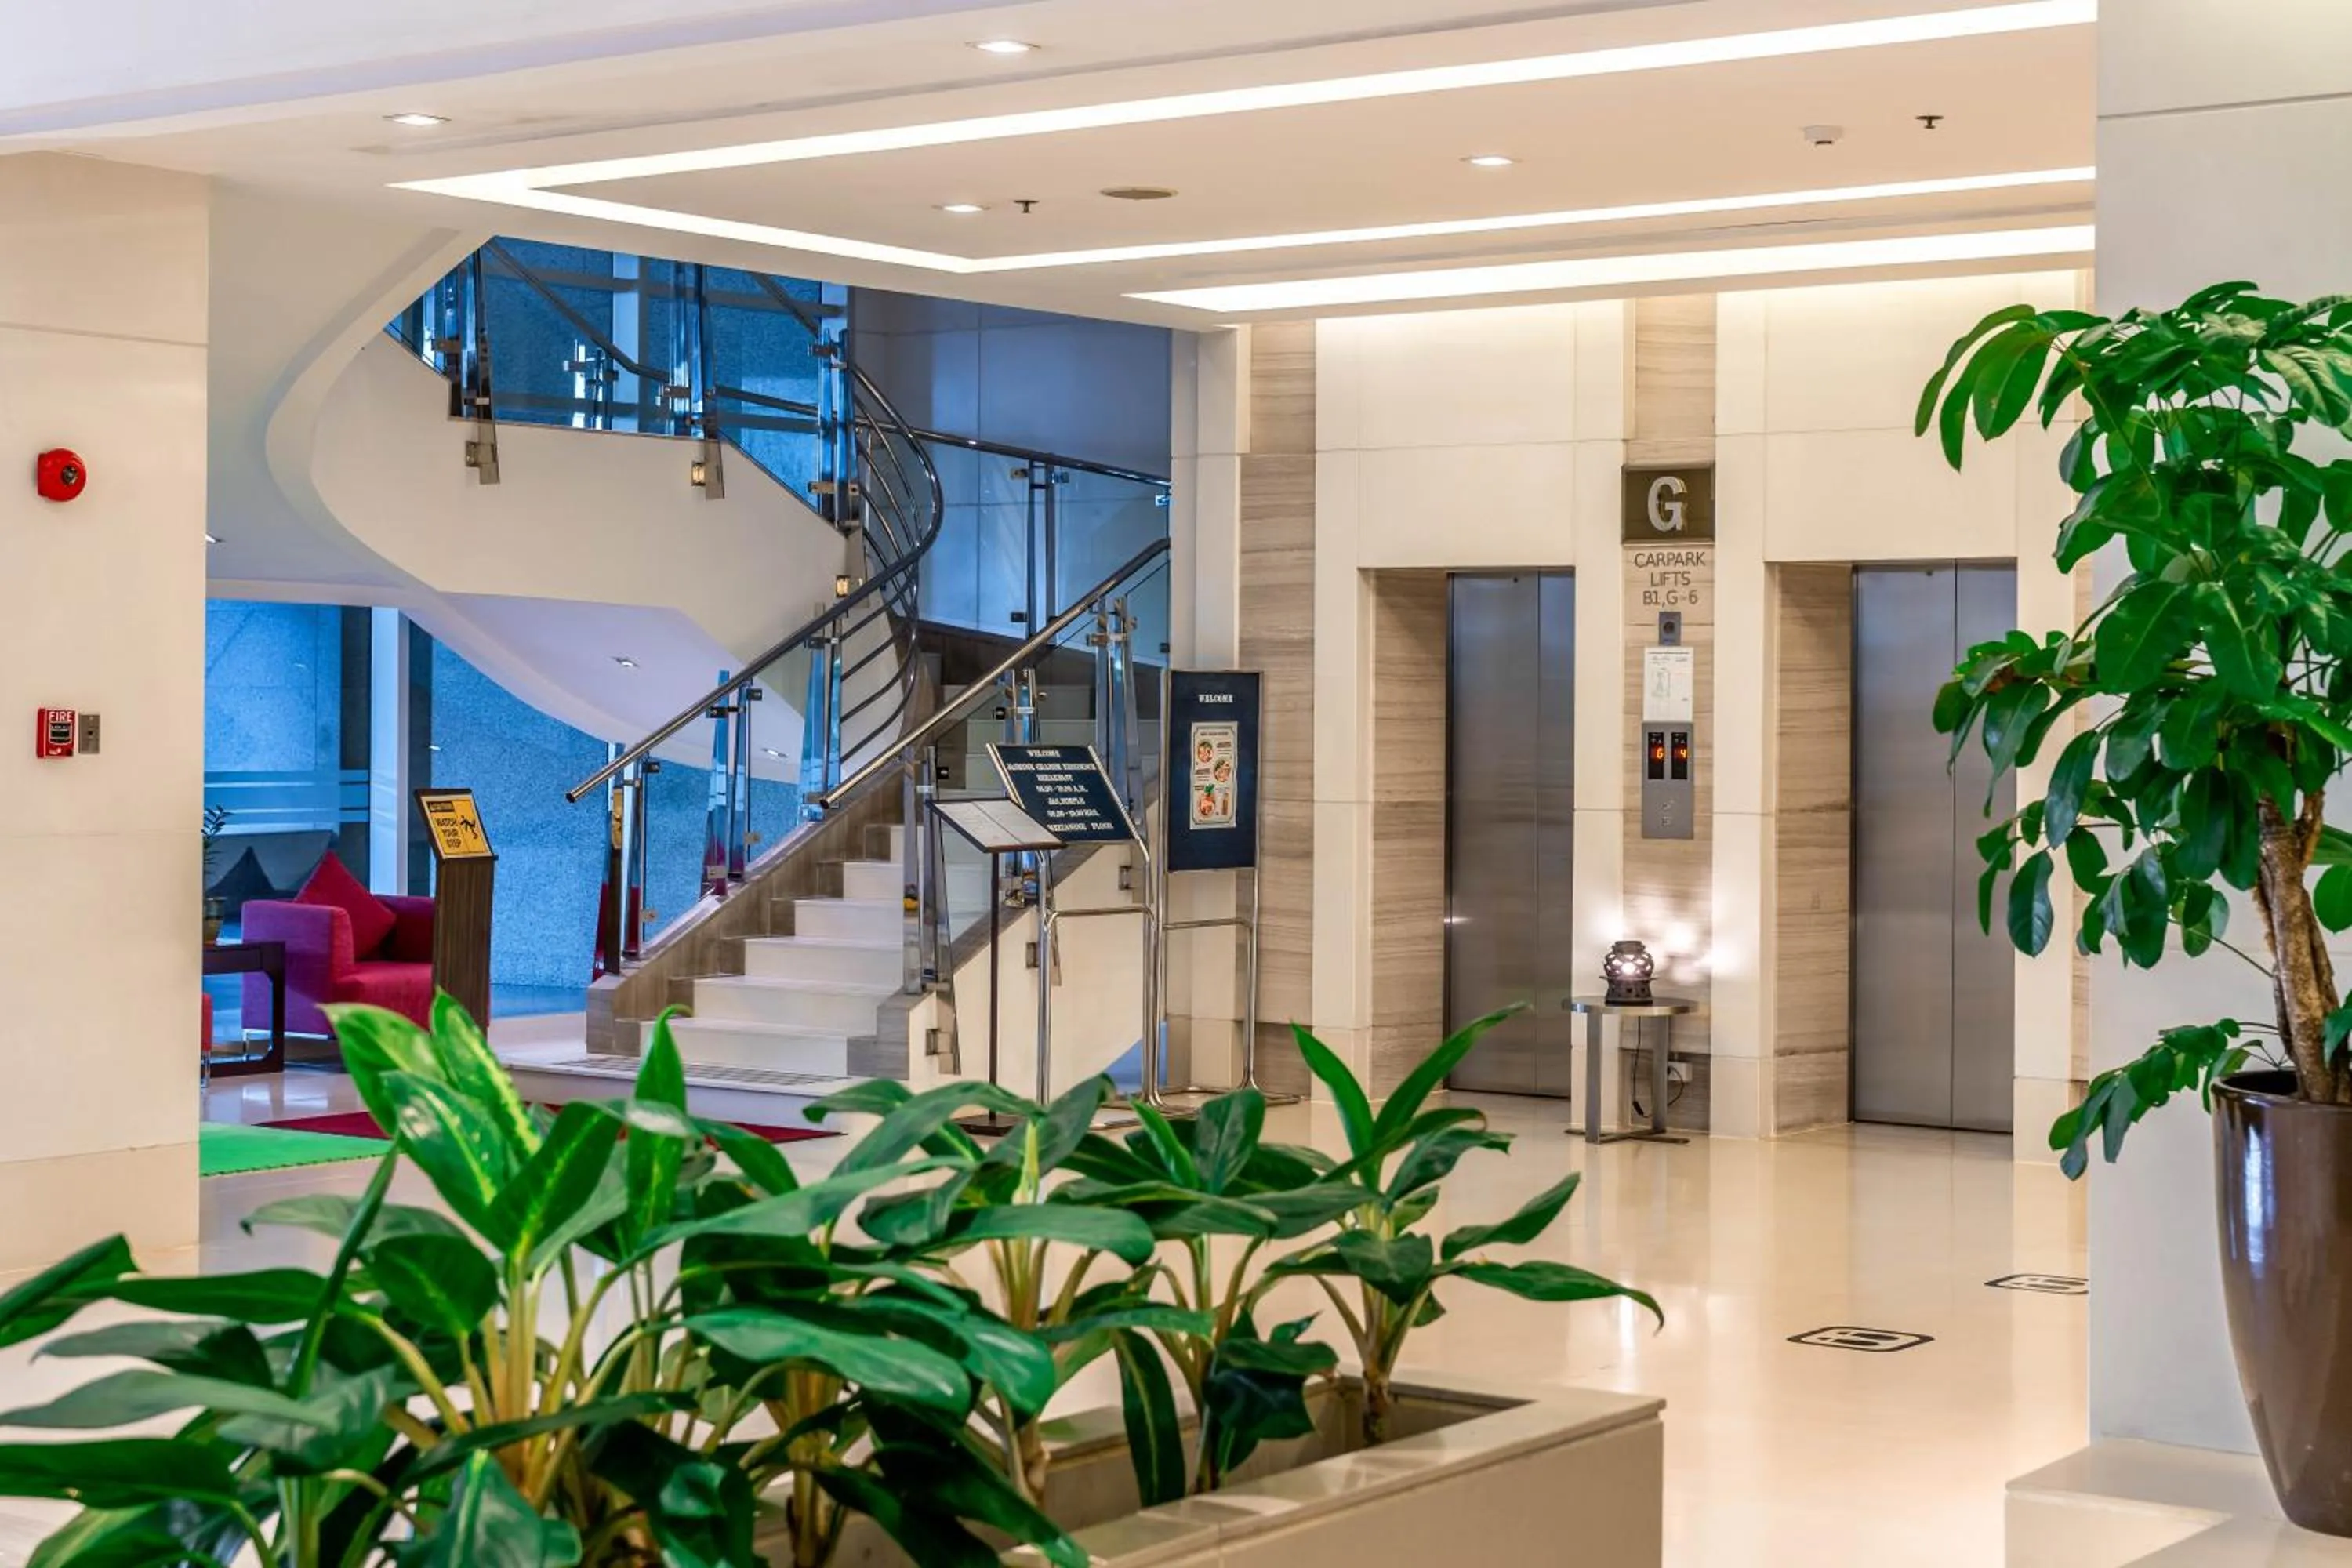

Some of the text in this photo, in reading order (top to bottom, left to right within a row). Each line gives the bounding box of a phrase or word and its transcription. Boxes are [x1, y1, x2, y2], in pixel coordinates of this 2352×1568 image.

[1648, 476, 1687, 532] G
[1634, 551, 1706, 568] CARPARK
[1650, 571, 1691, 587] LIFTS
[1198, 694, 1233, 703] WELCOME
[49, 711, 72, 722] FIRE
[1027, 749, 1060, 757] WELCOME
[435, 818, 458, 827] WATCH
[441, 829, 459, 838] YOUR
[446, 838, 461, 848] STEP
